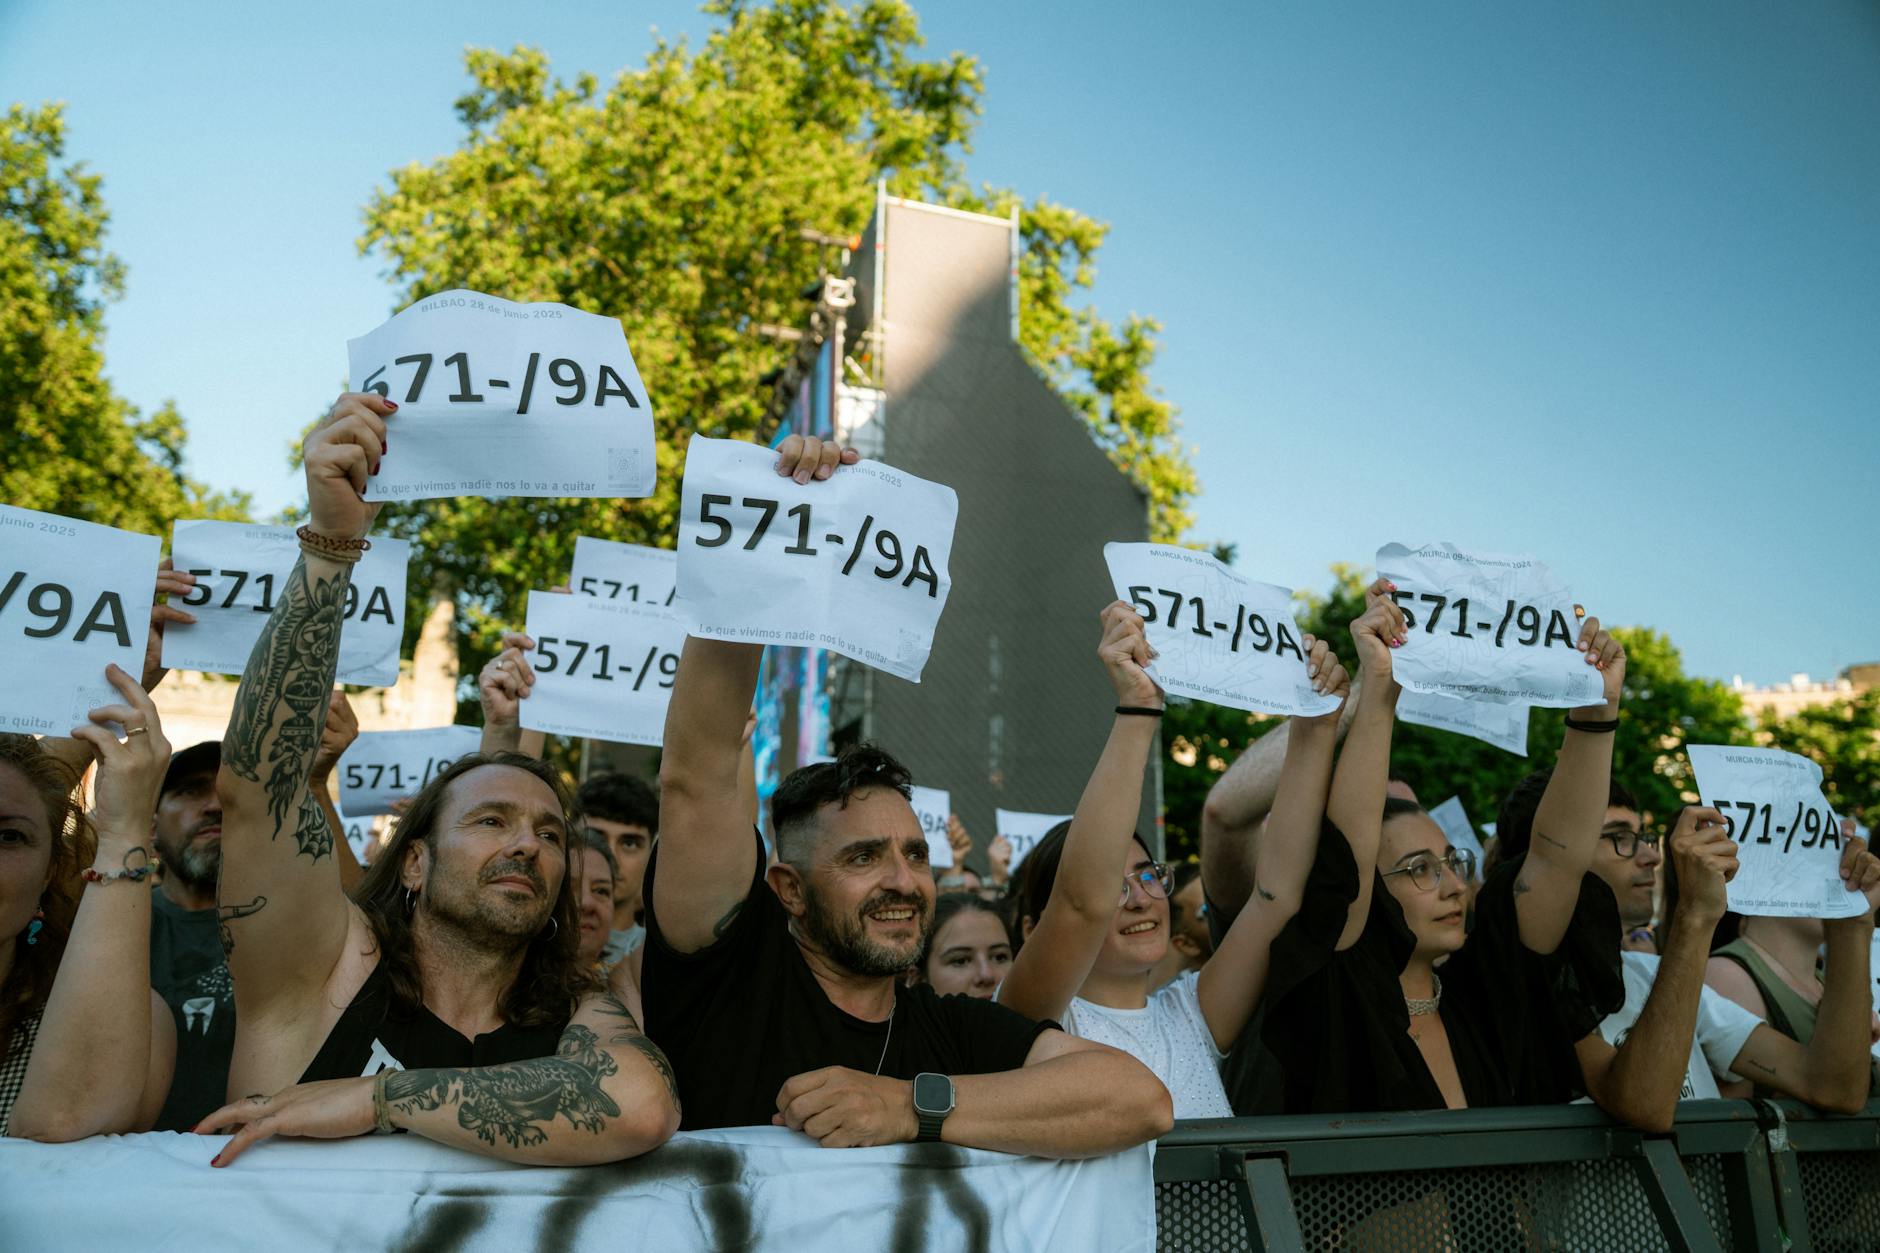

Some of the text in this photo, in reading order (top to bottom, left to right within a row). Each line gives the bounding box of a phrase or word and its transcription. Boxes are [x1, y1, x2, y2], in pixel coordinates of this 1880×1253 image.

[421, 298, 562, 320] BILBAO 28 de junio 2025
[376, 484, 388, 494] Lo
[392, 484, 410, 496] que
[414, 480, 456, 492] vivimos
[460, 479, 492, 490] nadie
[496, 480, 516, 490] nos
[520, 479, 530, 490] lo
[535, 481, 548, 490] va
[552, 481, 559, 490] a
[562, 479, 596, 493] quitar
[851, 465, 876, 477] junio
[879, 472, 903, 488] 2025
[0, 513, 78, 538] junio 2025
[695, 493, 938, 598] 571-/9A
[1128, 586, 1304, 663] 571-/9A
[1391, 590, 1577, 649] 571-/9A
[699, 624, 712, 633] Lo
[716, 626, 736, 637] que
[739, 627, 781, 639] vivimos
[785, 630, 815, 641] nadie
[820, 633, 836, 645] nos
[838, 637, 845, 648] lo
[847, 643, 857, 653] va
[865, 649, 888, 664] quitar
[1169, 677, 1185, 687] plan
[1186, 681, 1200, 691] esta
[12, 715, 55, 730] quitar
[1712, 799, 1841, 854] 571-/9A
